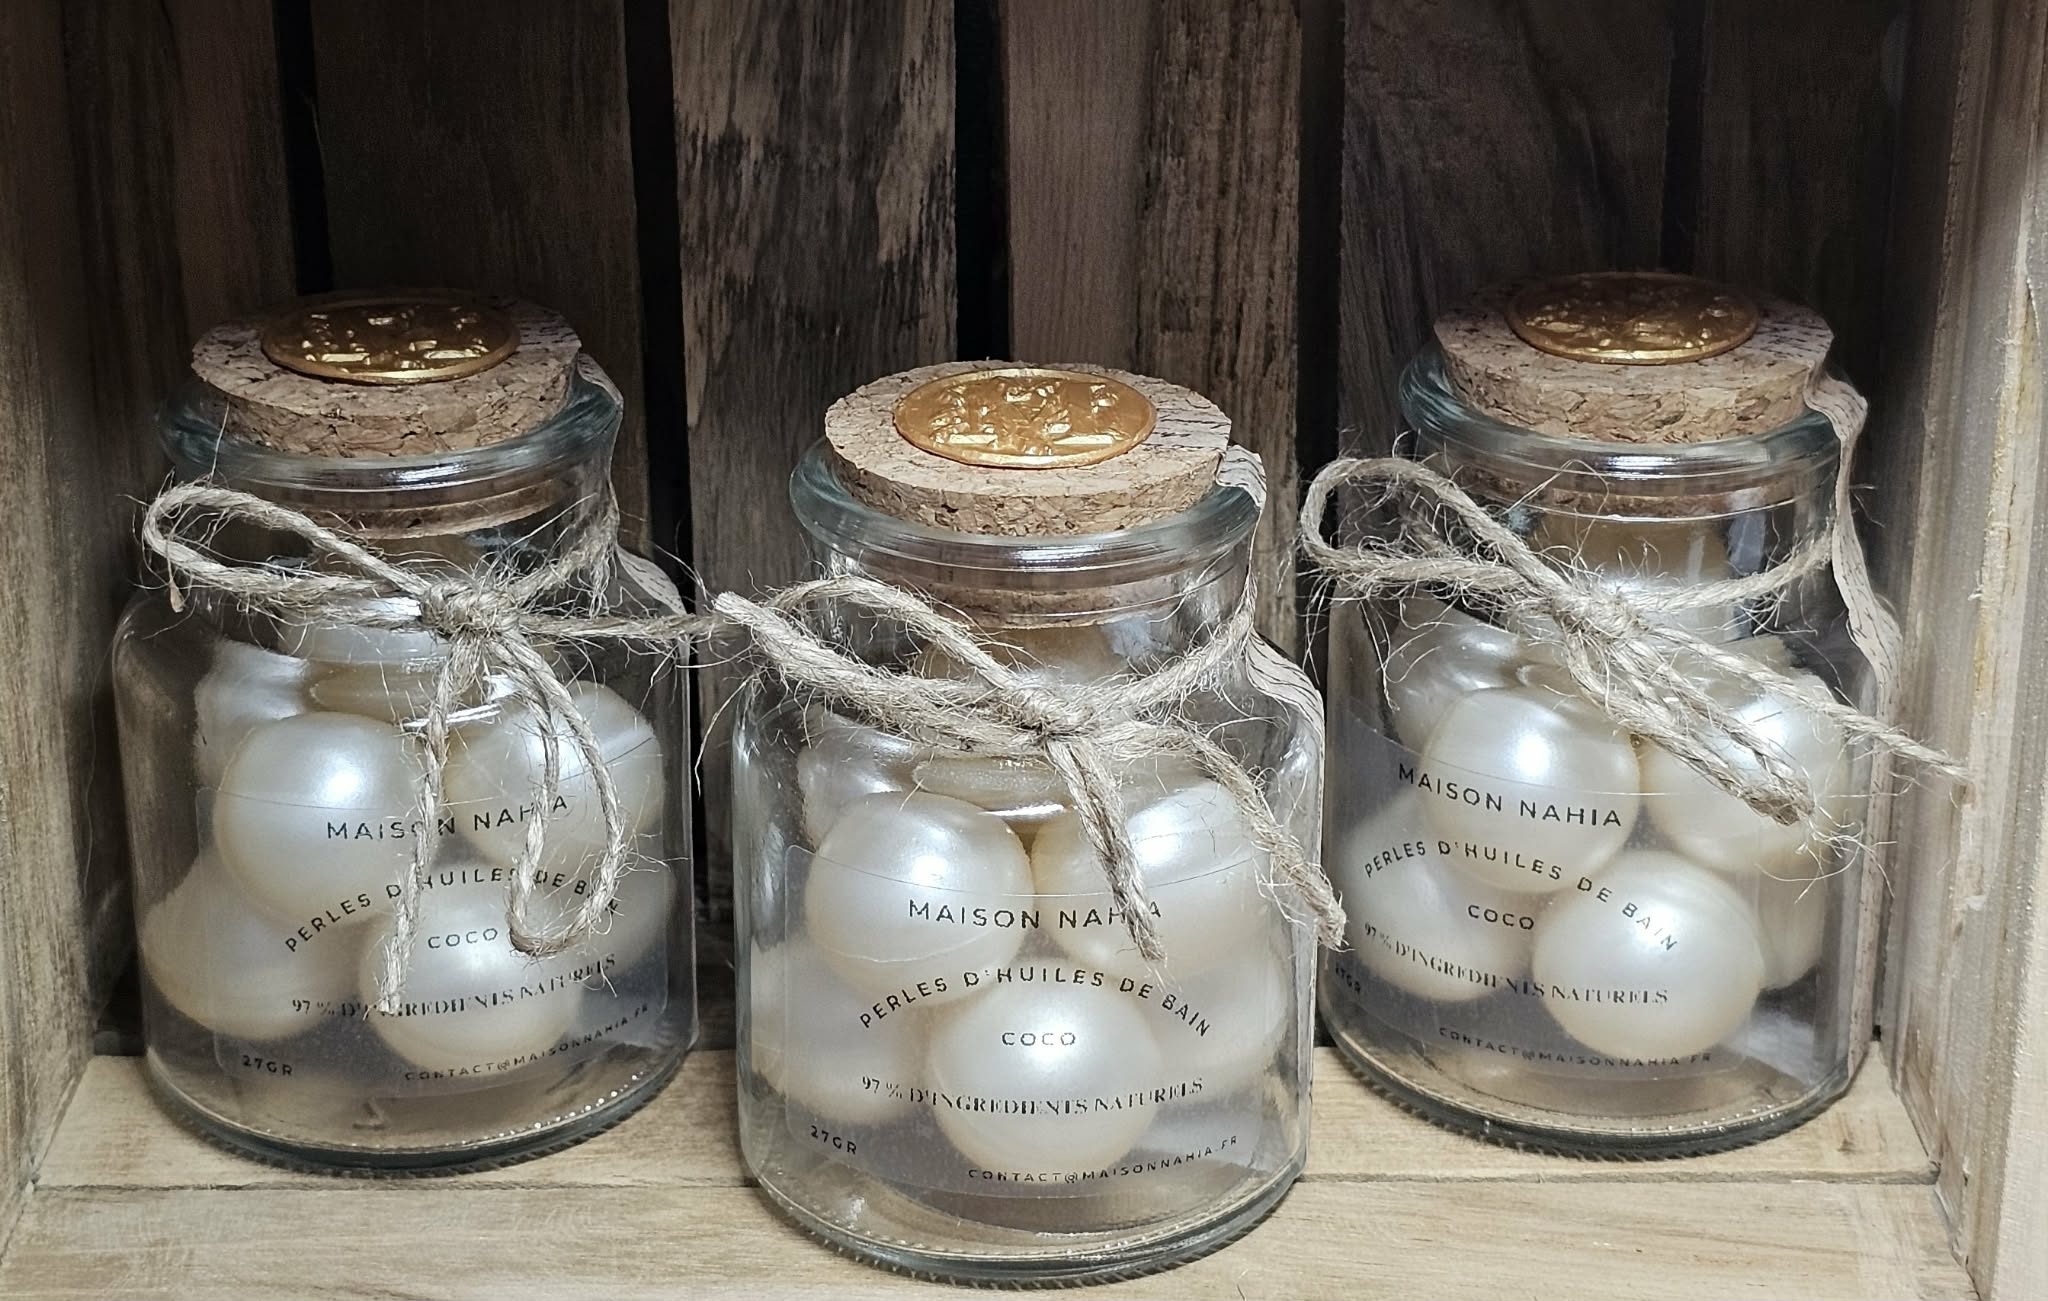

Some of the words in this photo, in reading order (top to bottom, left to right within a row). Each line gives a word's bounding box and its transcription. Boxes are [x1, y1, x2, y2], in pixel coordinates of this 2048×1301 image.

[474, 795, 568, 831] NAHA
[1399, 764, 1502, 812] MAISON
[1520, 800, 1622, 827] NAHIA
[285, 893, 371, 952] PERLES
[533, 870, 566, 888] DE
[574, 880, 619, 915] BN
[1365, 841, 1426, 878] PERLES
[1438, 840, 1562, 880] D'HUILES
[1576, 877, 1613, 903] DE
[1621, 902, 1678, 951] BAIN
[909, 900, 1040, 928] MAISON
[1060, 901, 1161, 928] NAHA
[1364, 923, 1377, 937] 97
[1467, 904, 1534, 930] COCO
[428, 928, 498, 949] COCO
[292, 1000, 311, 1014] 97
[342, 989, 514, 1019] D'IREDIENTS
[859, 978, 947, 1028] PERLES
[963, 967, 1104, 987] D'HUILES
[1119, 978, 1153, 999] DE
[1161, 994, 1211, 1037] BAIN
[405, 1003, 648, 1081] CONTACT@MAISONNAHIAFR
[1001, 1032, 1076, 1046] COCO
[1439, 1026, 1712, 1067] CONTACT@MAISONNAHIAFR
[242, 1055, 293, 1076] 27GR
[862, 1076, 880, 1093] 97
[886, 1082, 903, 1099] %
[1095, 1078, 1203, 1111] NATURELS
[810, 1125, 857, 1155] 27GR
[968, 1135, 1237, 1184] CONTACT@MAISONNAHIA.FR
